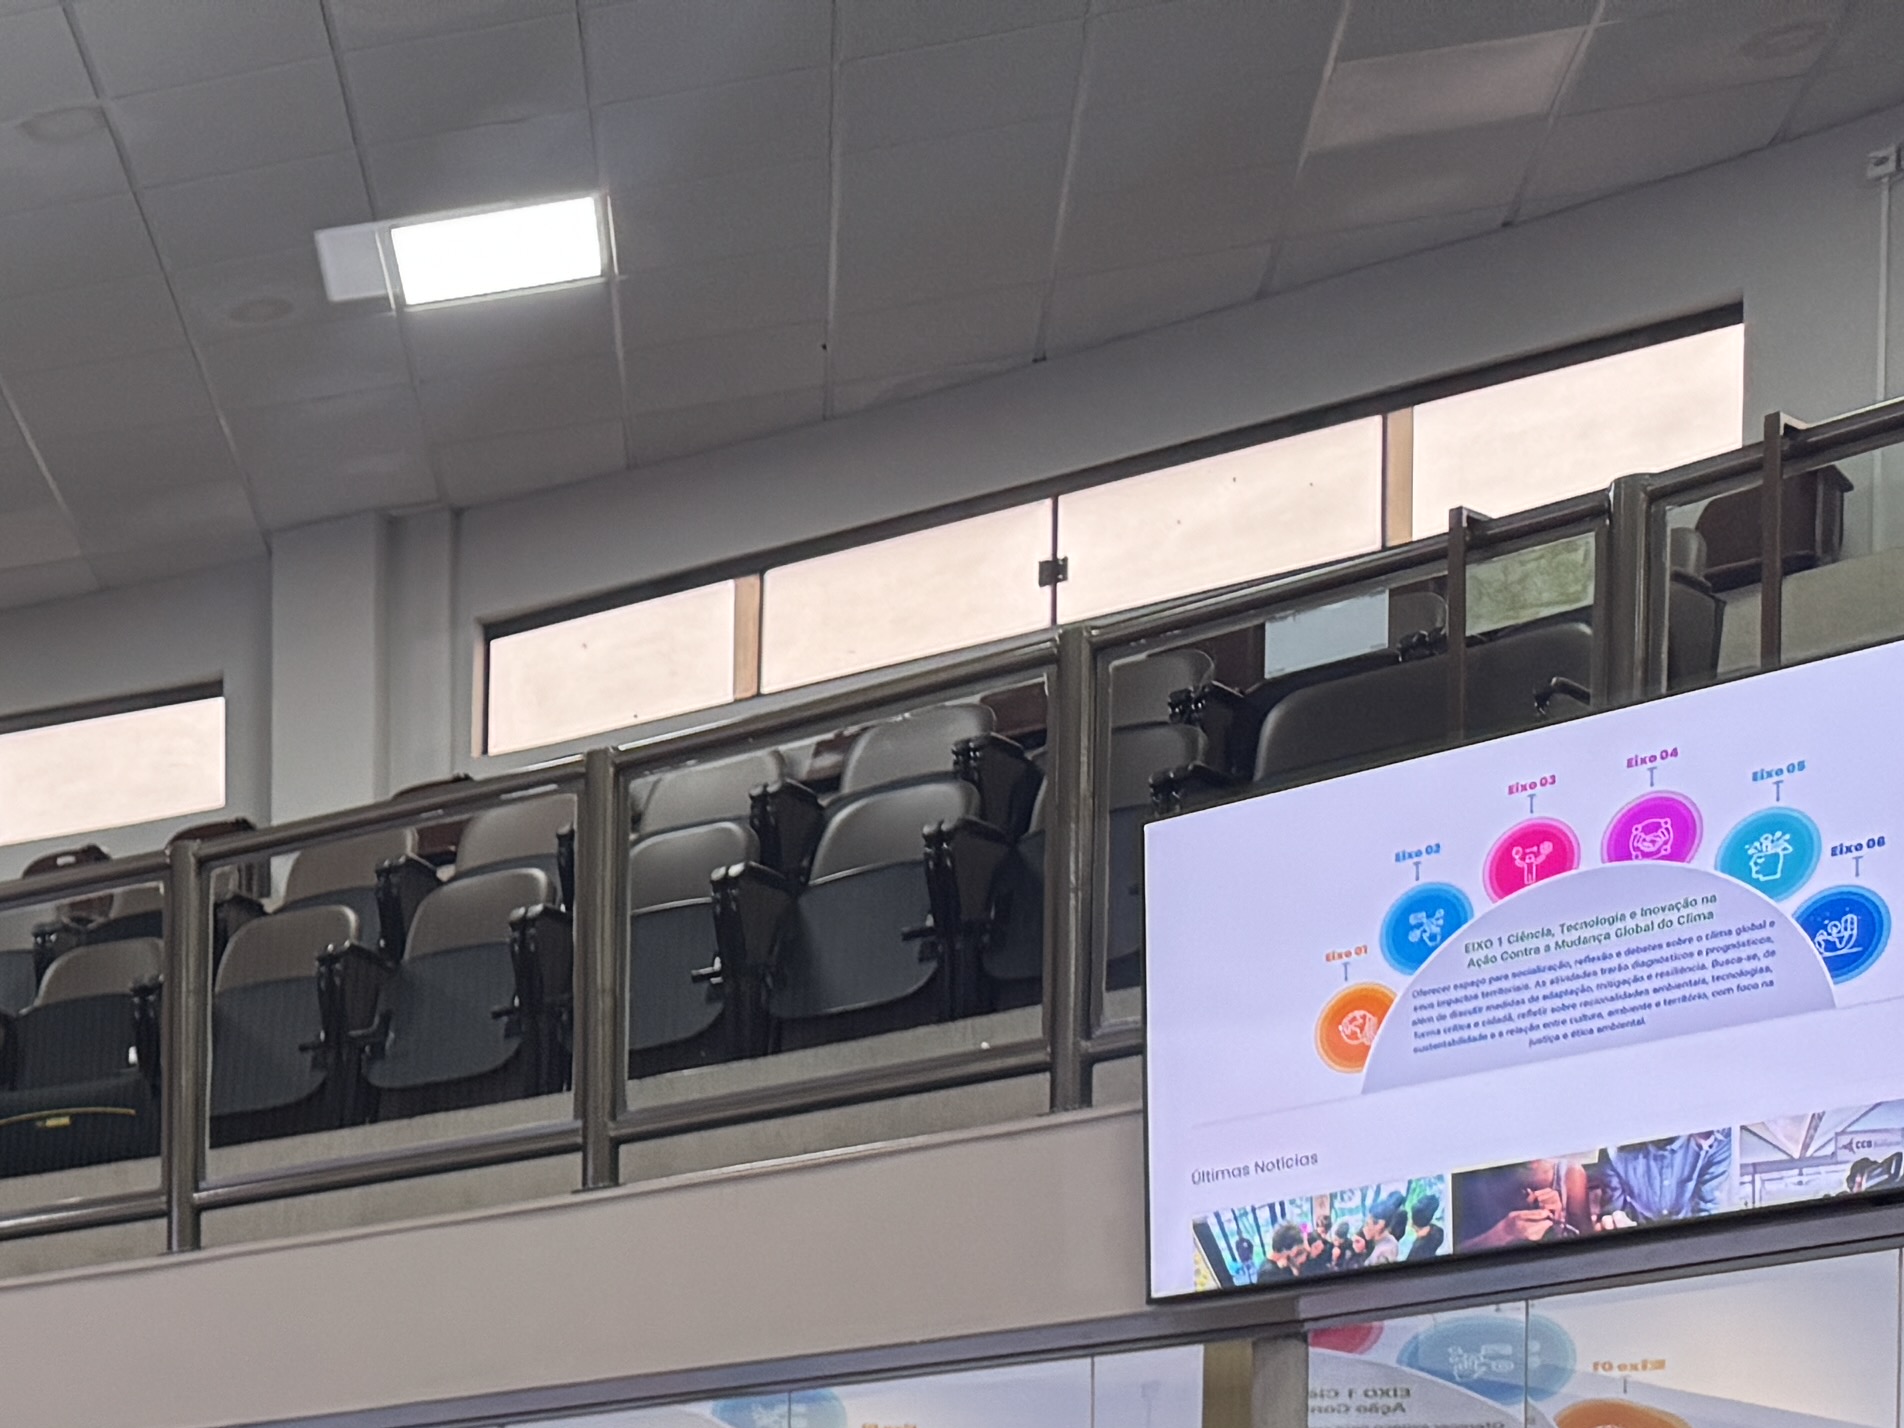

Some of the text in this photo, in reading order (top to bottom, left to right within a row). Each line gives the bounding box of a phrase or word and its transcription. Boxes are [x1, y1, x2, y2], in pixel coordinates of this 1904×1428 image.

[1627, 747, 1678, 768] Eixo 04
[1752, 760, 1806, 782] Eixo 05
[1508, 774, 1556, 795] Eixo 03
[1395, 843, 1441, 863] Eixo 02
[1831, 841, 1863, 857] Eixo
[1464, 894, 1717, 955] EIXO 1 Ciência, Tecnologia e Inovação na
[1467, 910, 1714, 969] Ação Contra a Mudança Global do Clima
[1325, 945, 1368, 963] Eixo 01
[1191, 1153, 1318, 1185] Últimas Notícias
